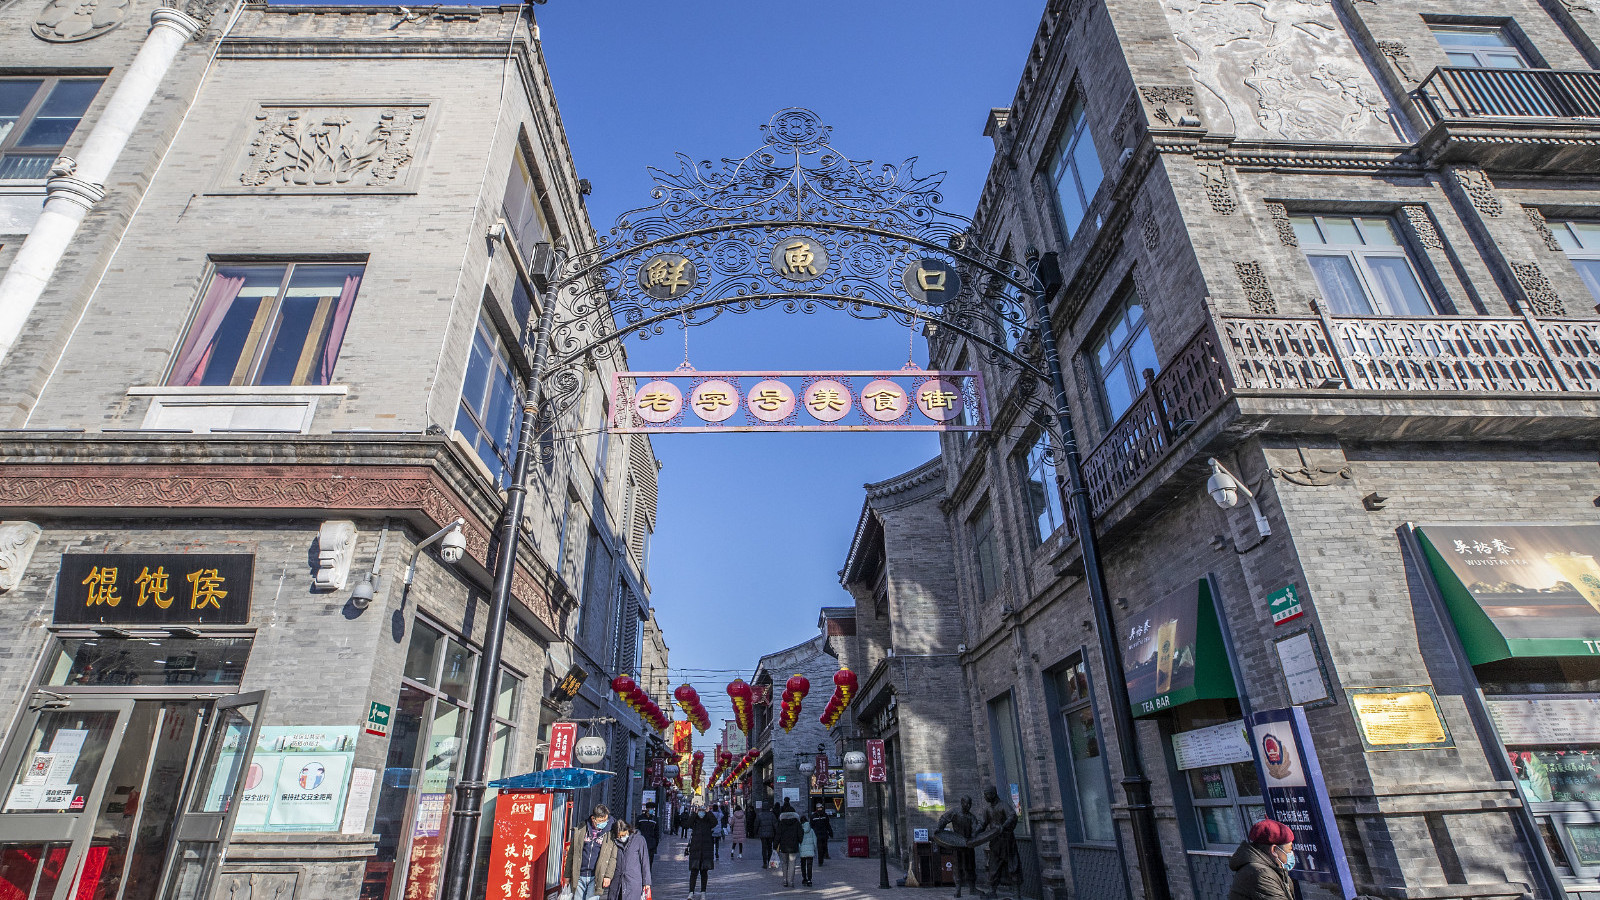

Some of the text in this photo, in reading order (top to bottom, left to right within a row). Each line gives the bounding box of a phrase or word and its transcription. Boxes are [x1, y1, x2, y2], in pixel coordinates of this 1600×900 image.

[639, 389, 958, 412] 老字号美食街
[82, 565, 229, 609] 馄饨侯
[1141, 695, 1170, 713] TEA BAR
